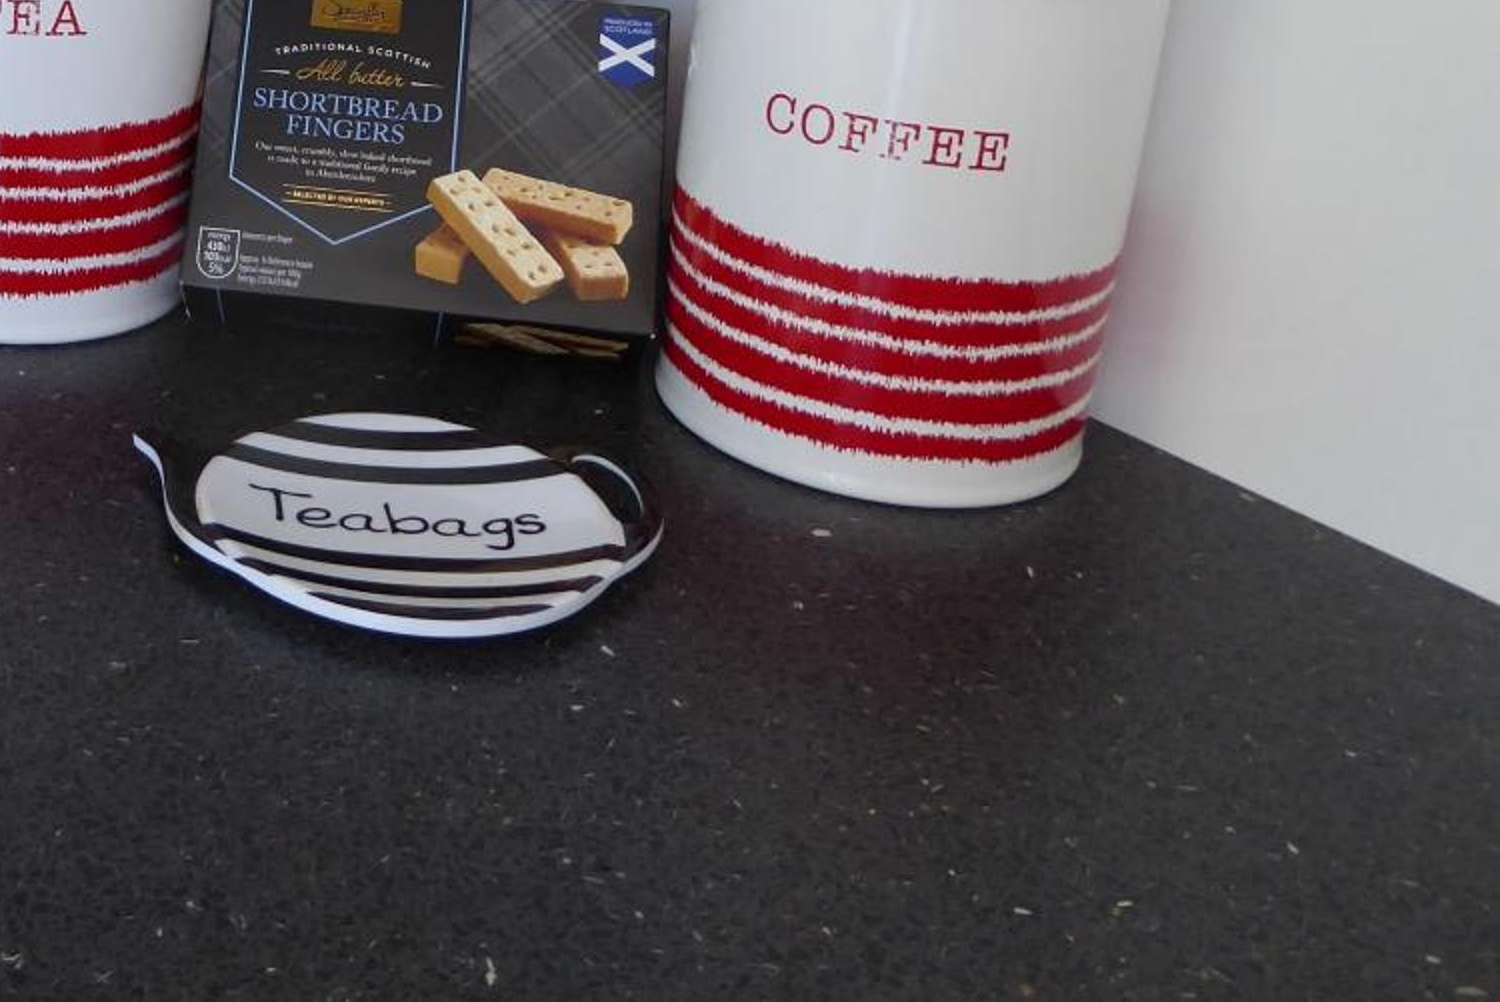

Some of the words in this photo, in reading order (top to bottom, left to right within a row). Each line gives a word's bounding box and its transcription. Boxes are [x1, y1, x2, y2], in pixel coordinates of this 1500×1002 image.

[275, 42, 362, 56] TRADITIONAL
[367, 45, 432, 69] SCOTTISH
[295, 58, 344, 82] All
[349, 62, 406, 87] butter
[253, 87, 444, 124] SHORTBREAD
[286, 114, 406, 145] FINGERS
[765, 93, 1010, 172] COFFEE
[248, 483, 547, 551] Teabags
